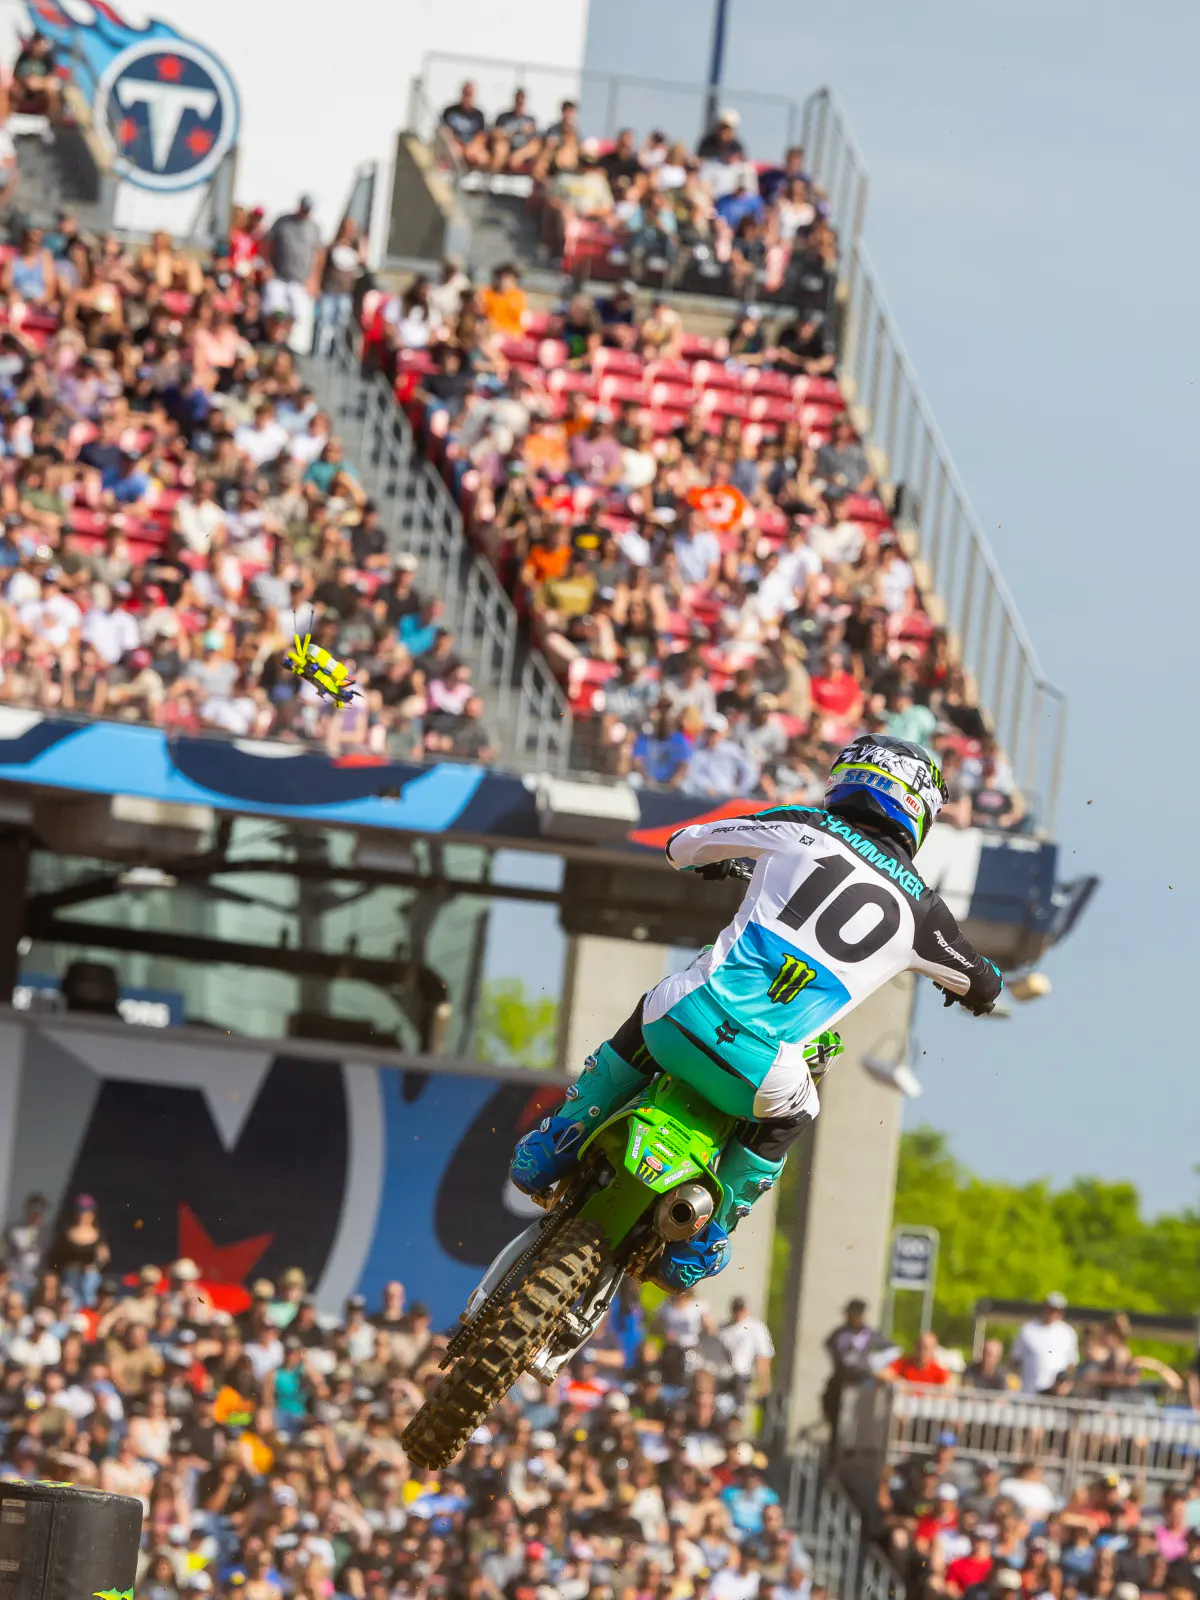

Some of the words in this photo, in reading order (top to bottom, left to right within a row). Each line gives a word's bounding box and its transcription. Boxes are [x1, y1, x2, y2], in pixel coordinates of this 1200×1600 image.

[842, 769, 896, 795] SETH
[905, 795, 921, 813] BELL
[820, 815, 925, 901] HAMMAKER
[776, 854, 900, 964] 10
[933, 929, 949, 948] PRO
[944, 946, 975, 969] CIRCUIT
